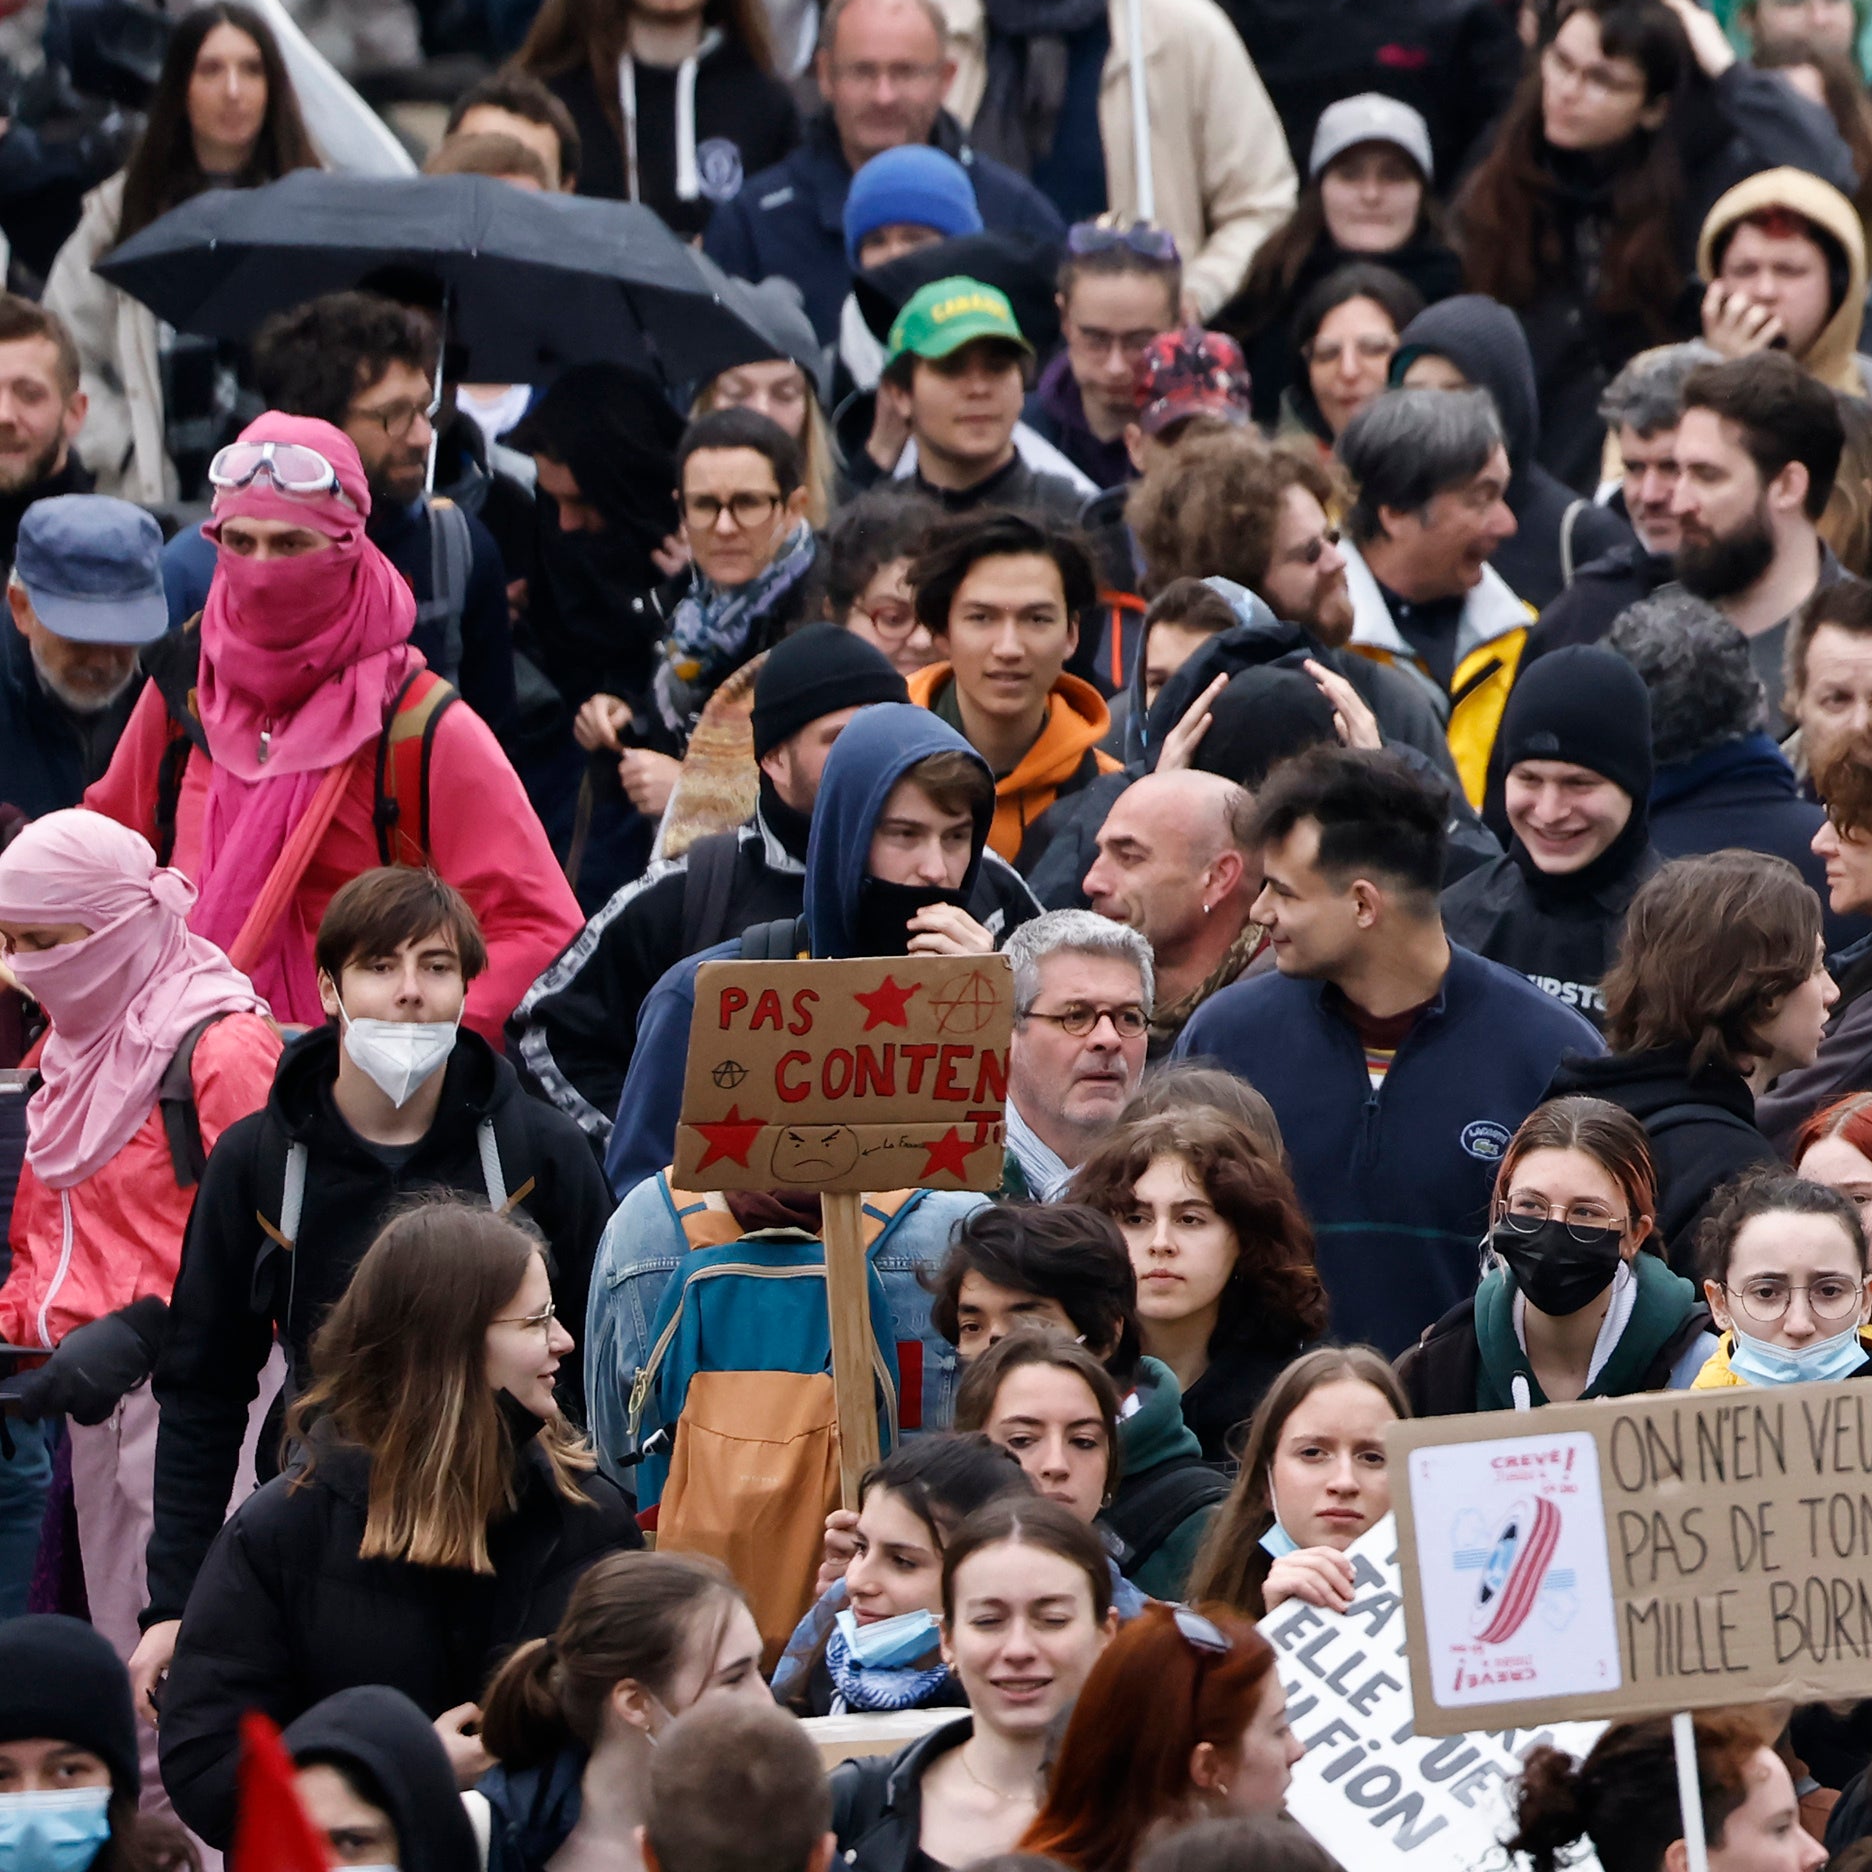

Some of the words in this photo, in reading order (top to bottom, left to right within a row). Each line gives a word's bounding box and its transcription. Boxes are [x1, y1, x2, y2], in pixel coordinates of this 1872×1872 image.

[718, 986, 821, 1036] PAS
[1610, 1409, 1685, 1493] ON
[1617, 1507, 1709, 1589] PAS
[1729, 1501, 1781, 1573] DE
[1269, 1605, 1404, 1720] ELLE
[1624, 1588, 1750, 1683] MILLE
